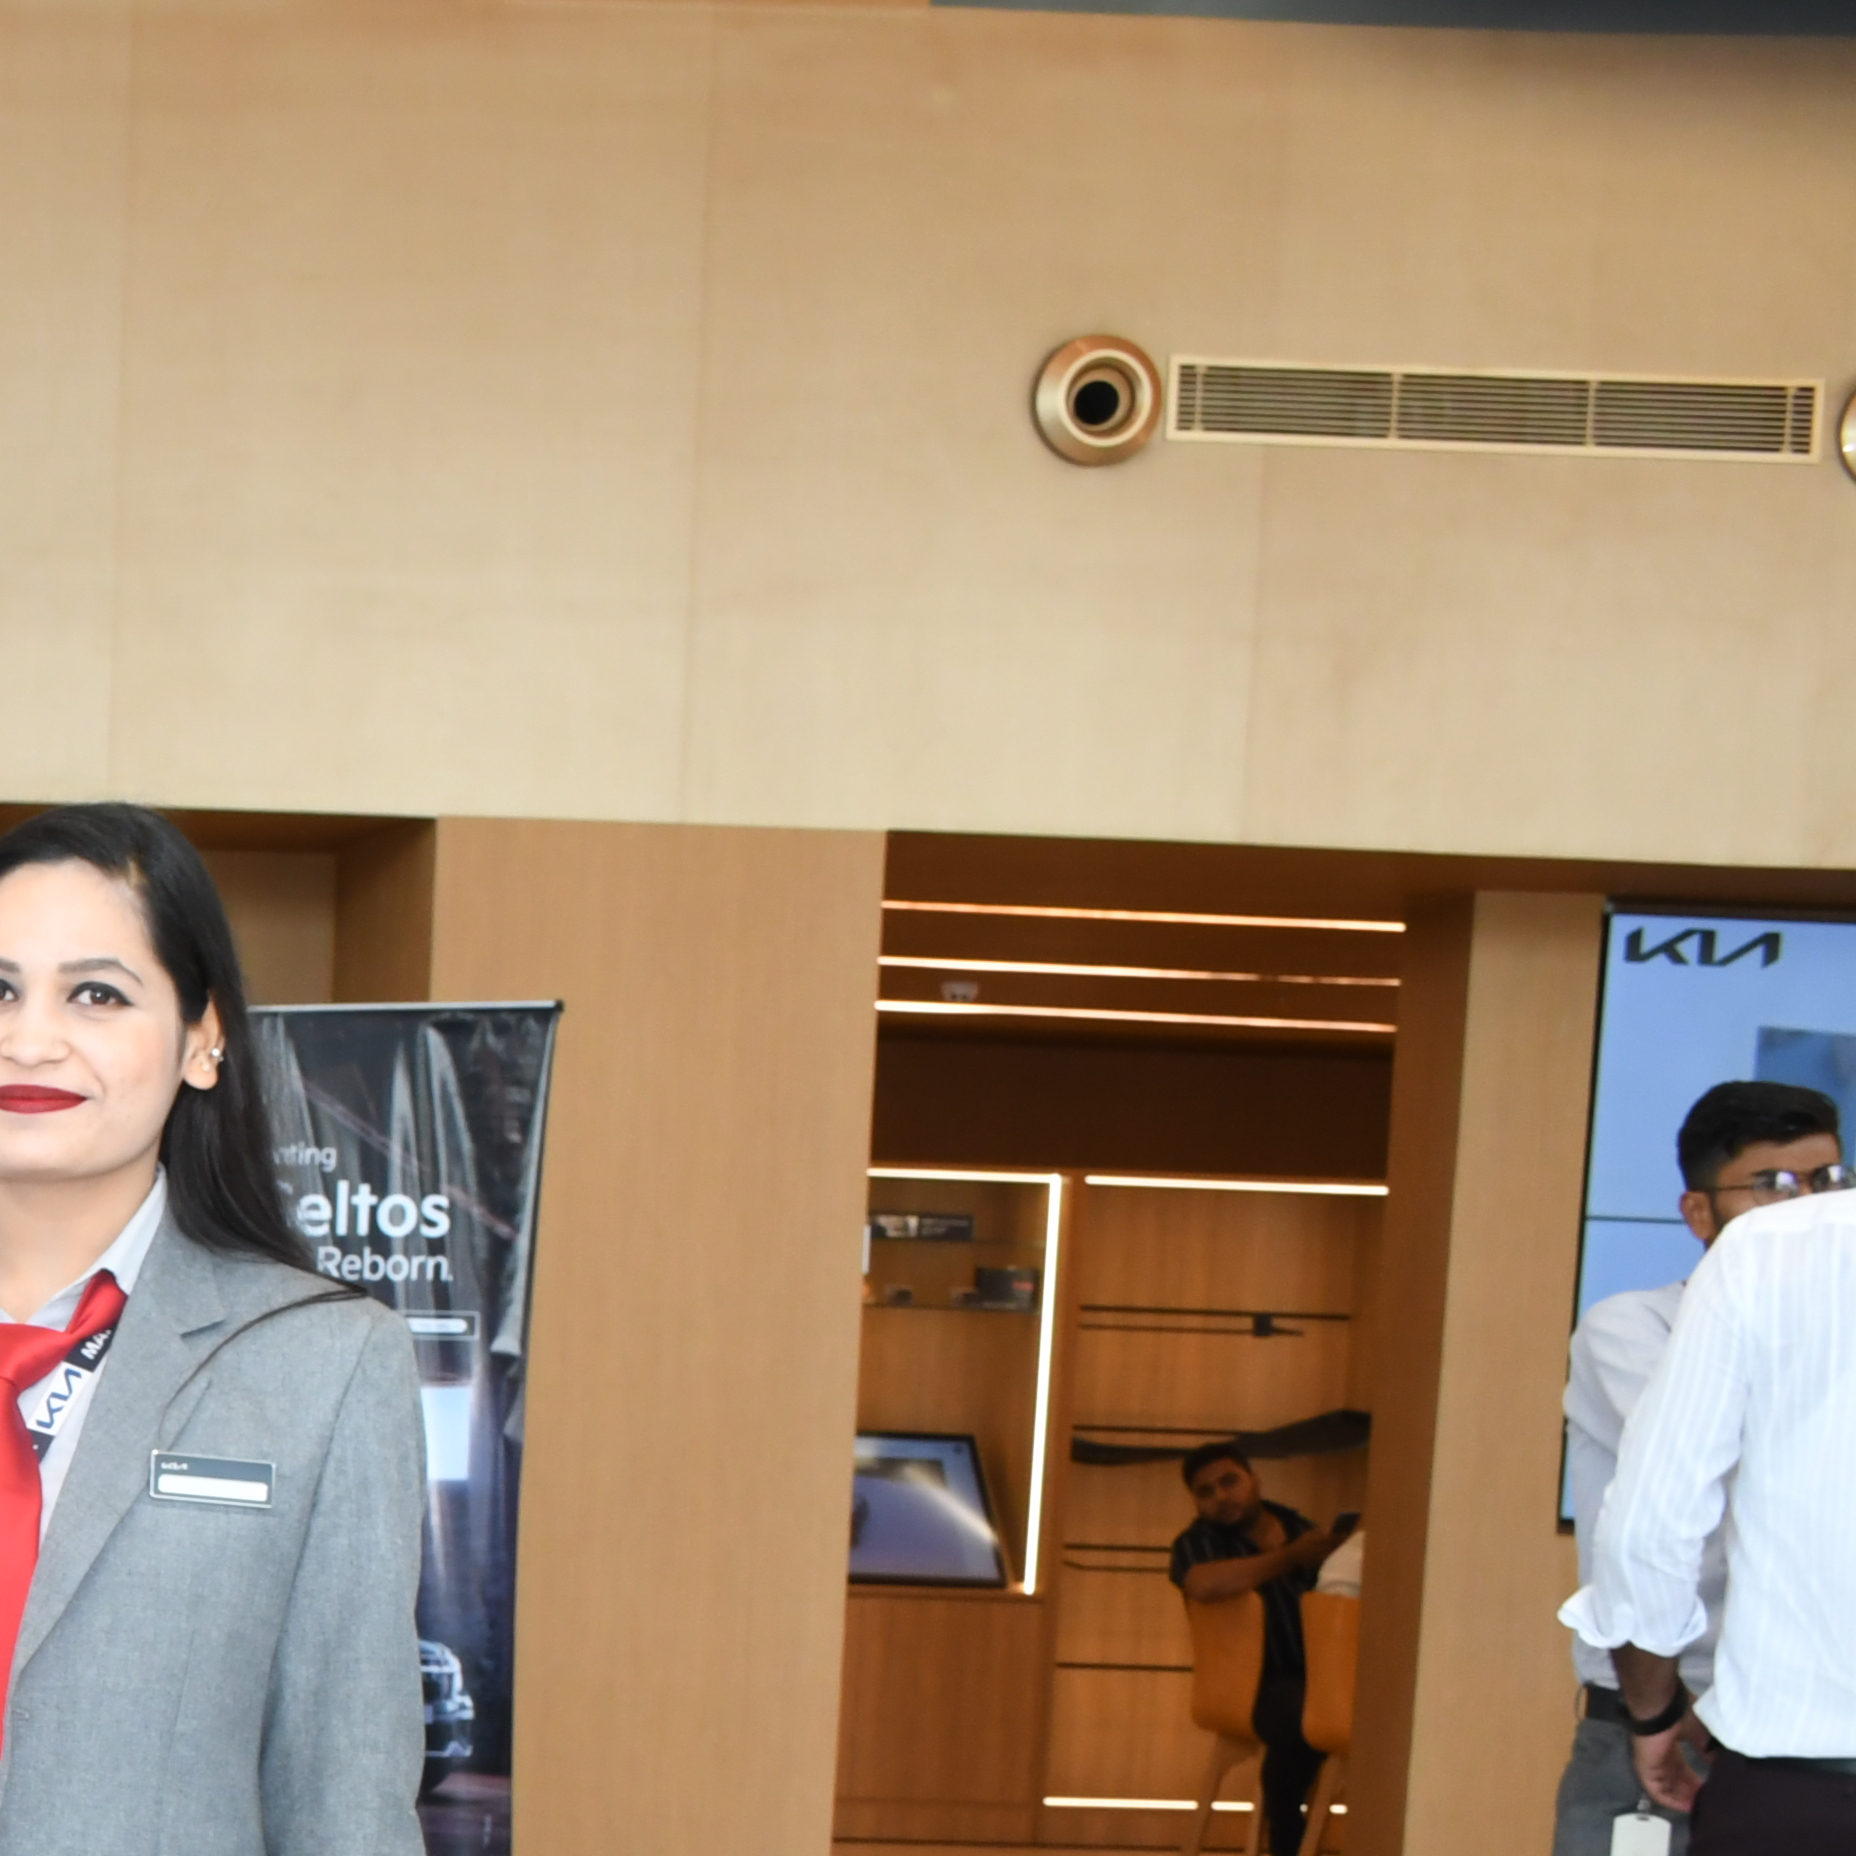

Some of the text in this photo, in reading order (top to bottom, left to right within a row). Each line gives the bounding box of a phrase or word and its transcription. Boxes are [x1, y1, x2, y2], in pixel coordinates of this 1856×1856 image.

[1623, 926, 1783, 968] KIA
[278, 1179, 451, 1239] eltos
[317, 1245, 454, 1282] Reborn.
